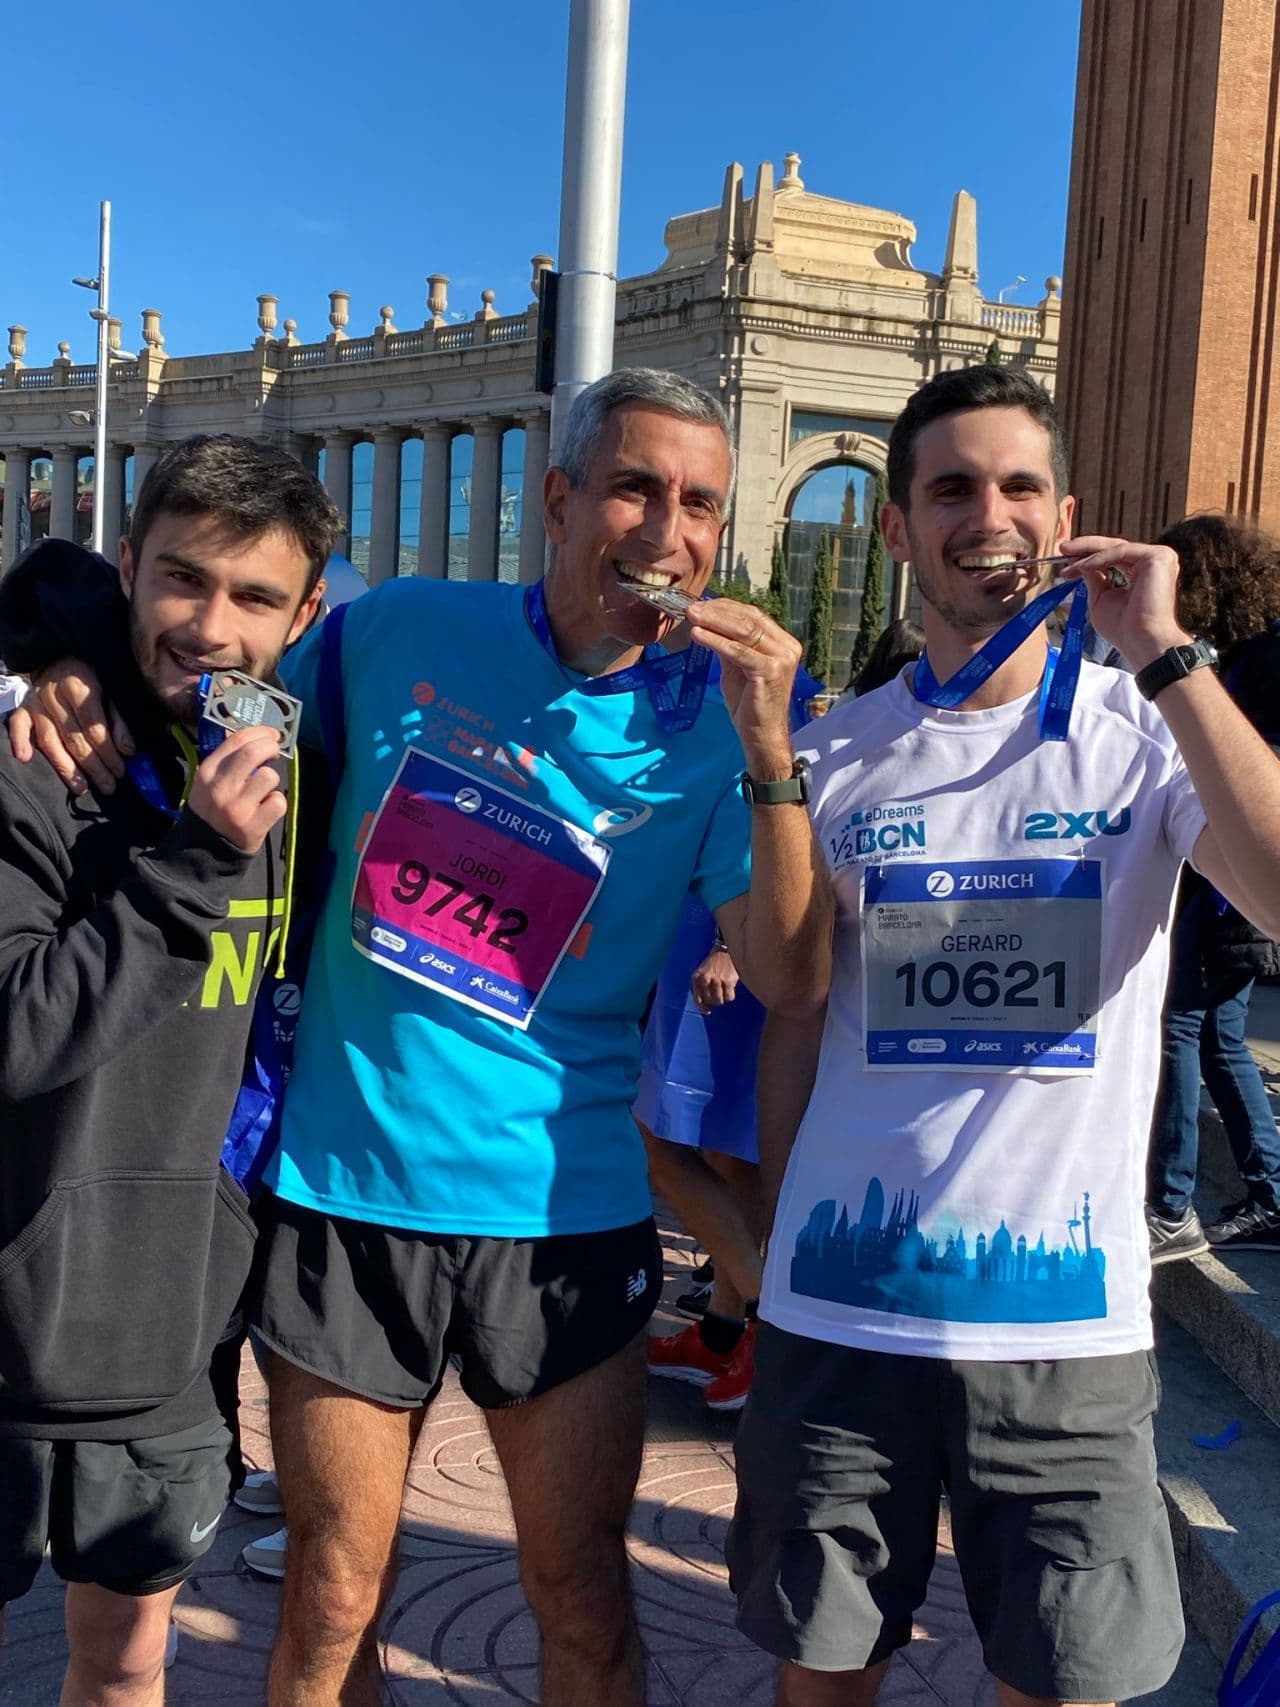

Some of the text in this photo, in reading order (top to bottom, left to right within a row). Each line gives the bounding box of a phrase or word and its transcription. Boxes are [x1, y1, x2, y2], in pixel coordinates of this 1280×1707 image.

[483, 803, 552, 845] ZURICH
[865, 804, 925, 822] eDreams
[1024, 807, 1132, 840] 2XU
[856, 820, 926, 855] BCN
[449, 853, 507, 889] JORDI
[884, 850, 927, 860] BARCELONA
[959, 873, 1034, 890] ZURICH
[391, 861, 529, 955] 9742
[941, 934, 1023, 952] GERARD
[896, 961, 1066, 1008] 10621
